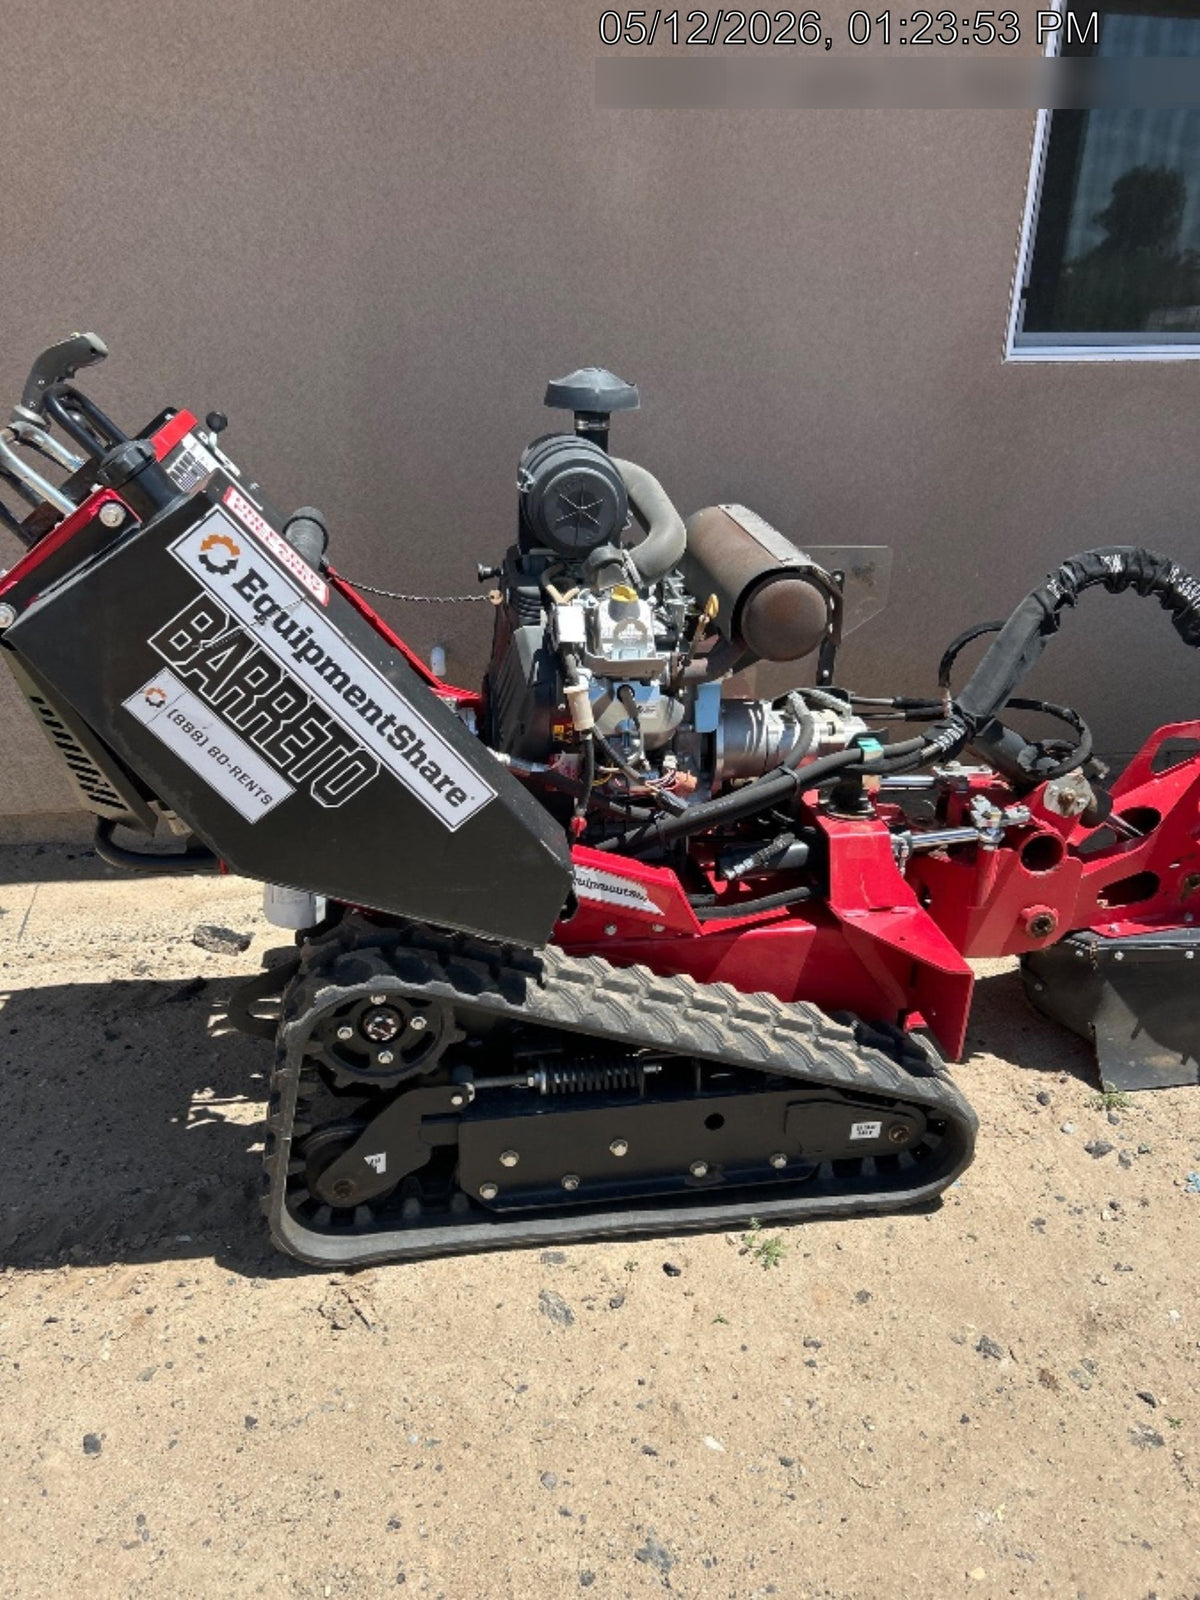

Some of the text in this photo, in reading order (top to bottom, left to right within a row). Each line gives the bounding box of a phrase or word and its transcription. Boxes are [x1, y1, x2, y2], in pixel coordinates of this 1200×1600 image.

[147, 590, 381, 808] BARRETO
[167, 708, 210, 748] (888)
[231, 567, 468, 808] EquipmentShare
